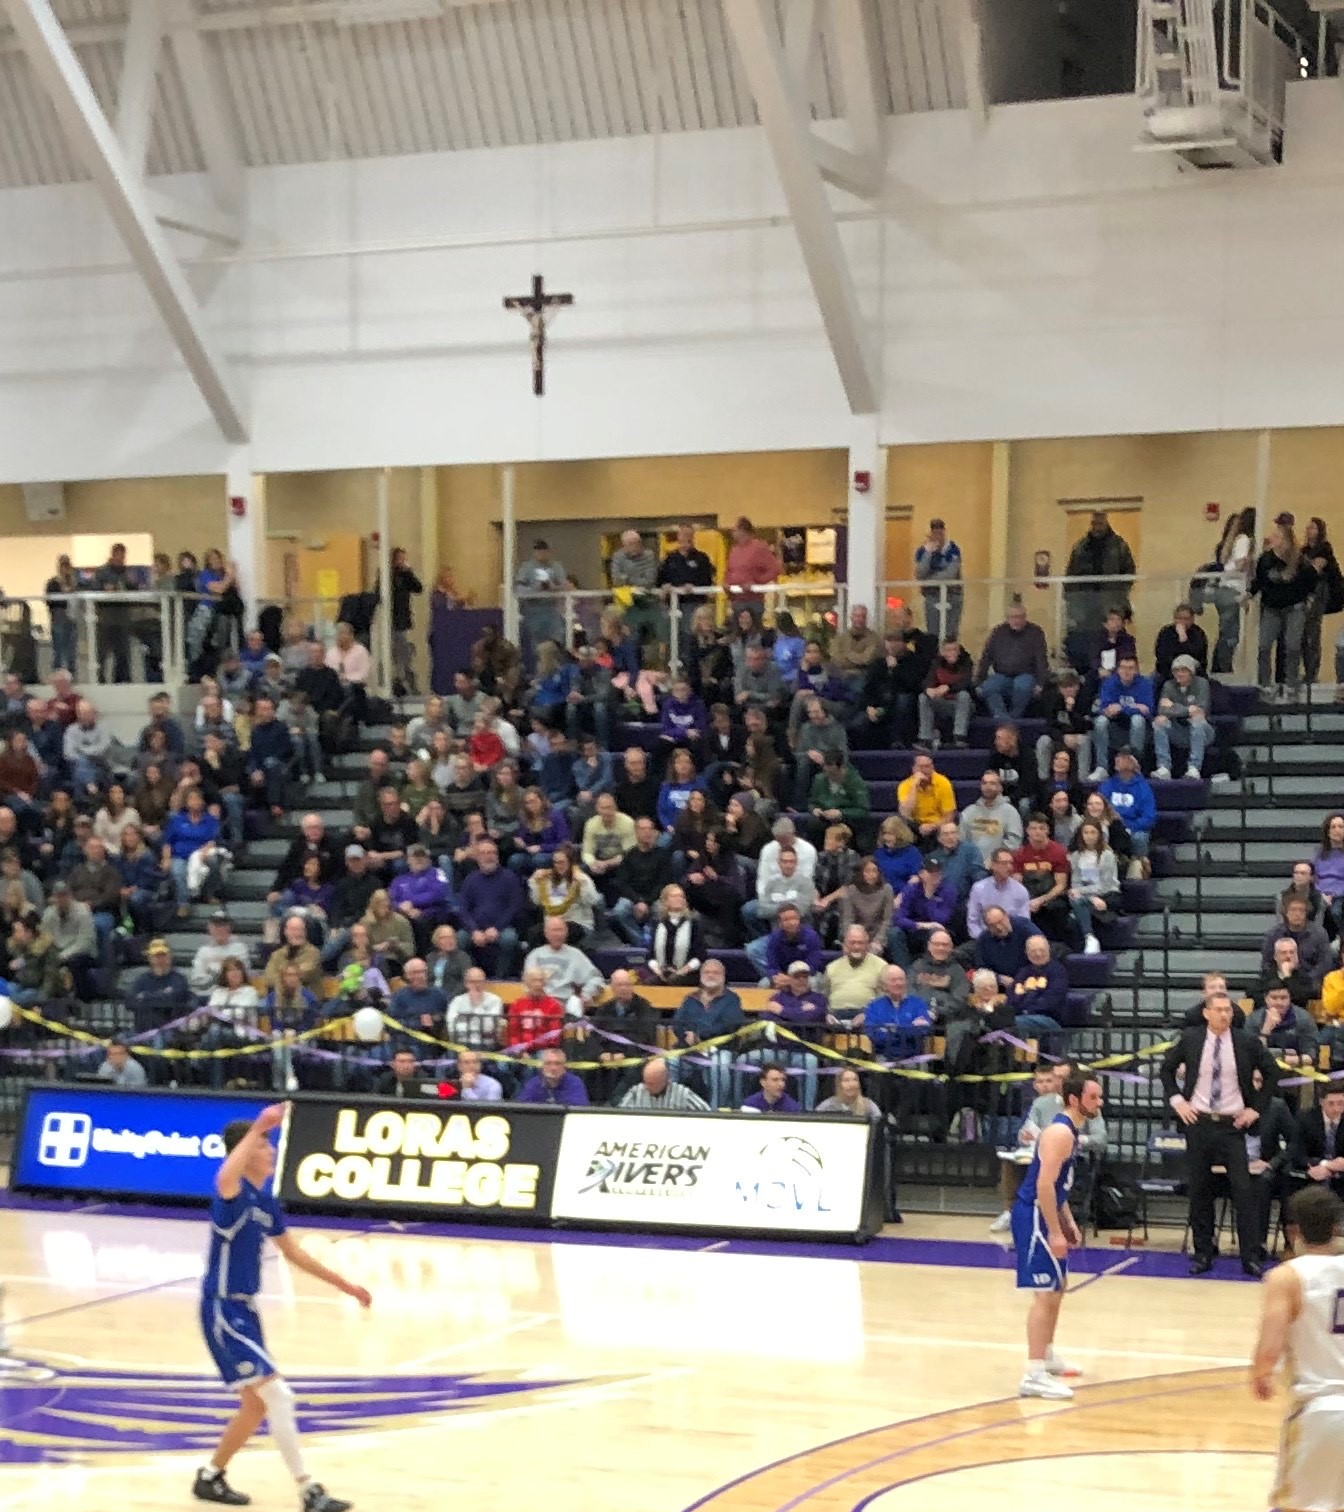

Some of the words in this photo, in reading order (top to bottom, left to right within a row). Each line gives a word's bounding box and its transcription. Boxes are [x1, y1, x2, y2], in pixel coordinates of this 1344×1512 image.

[334, 1109, 511, 1161] LORAS
[594, 1141, 711, 1162] AMERICAN
[296, 1152, 539, 1209] COLLEGE
